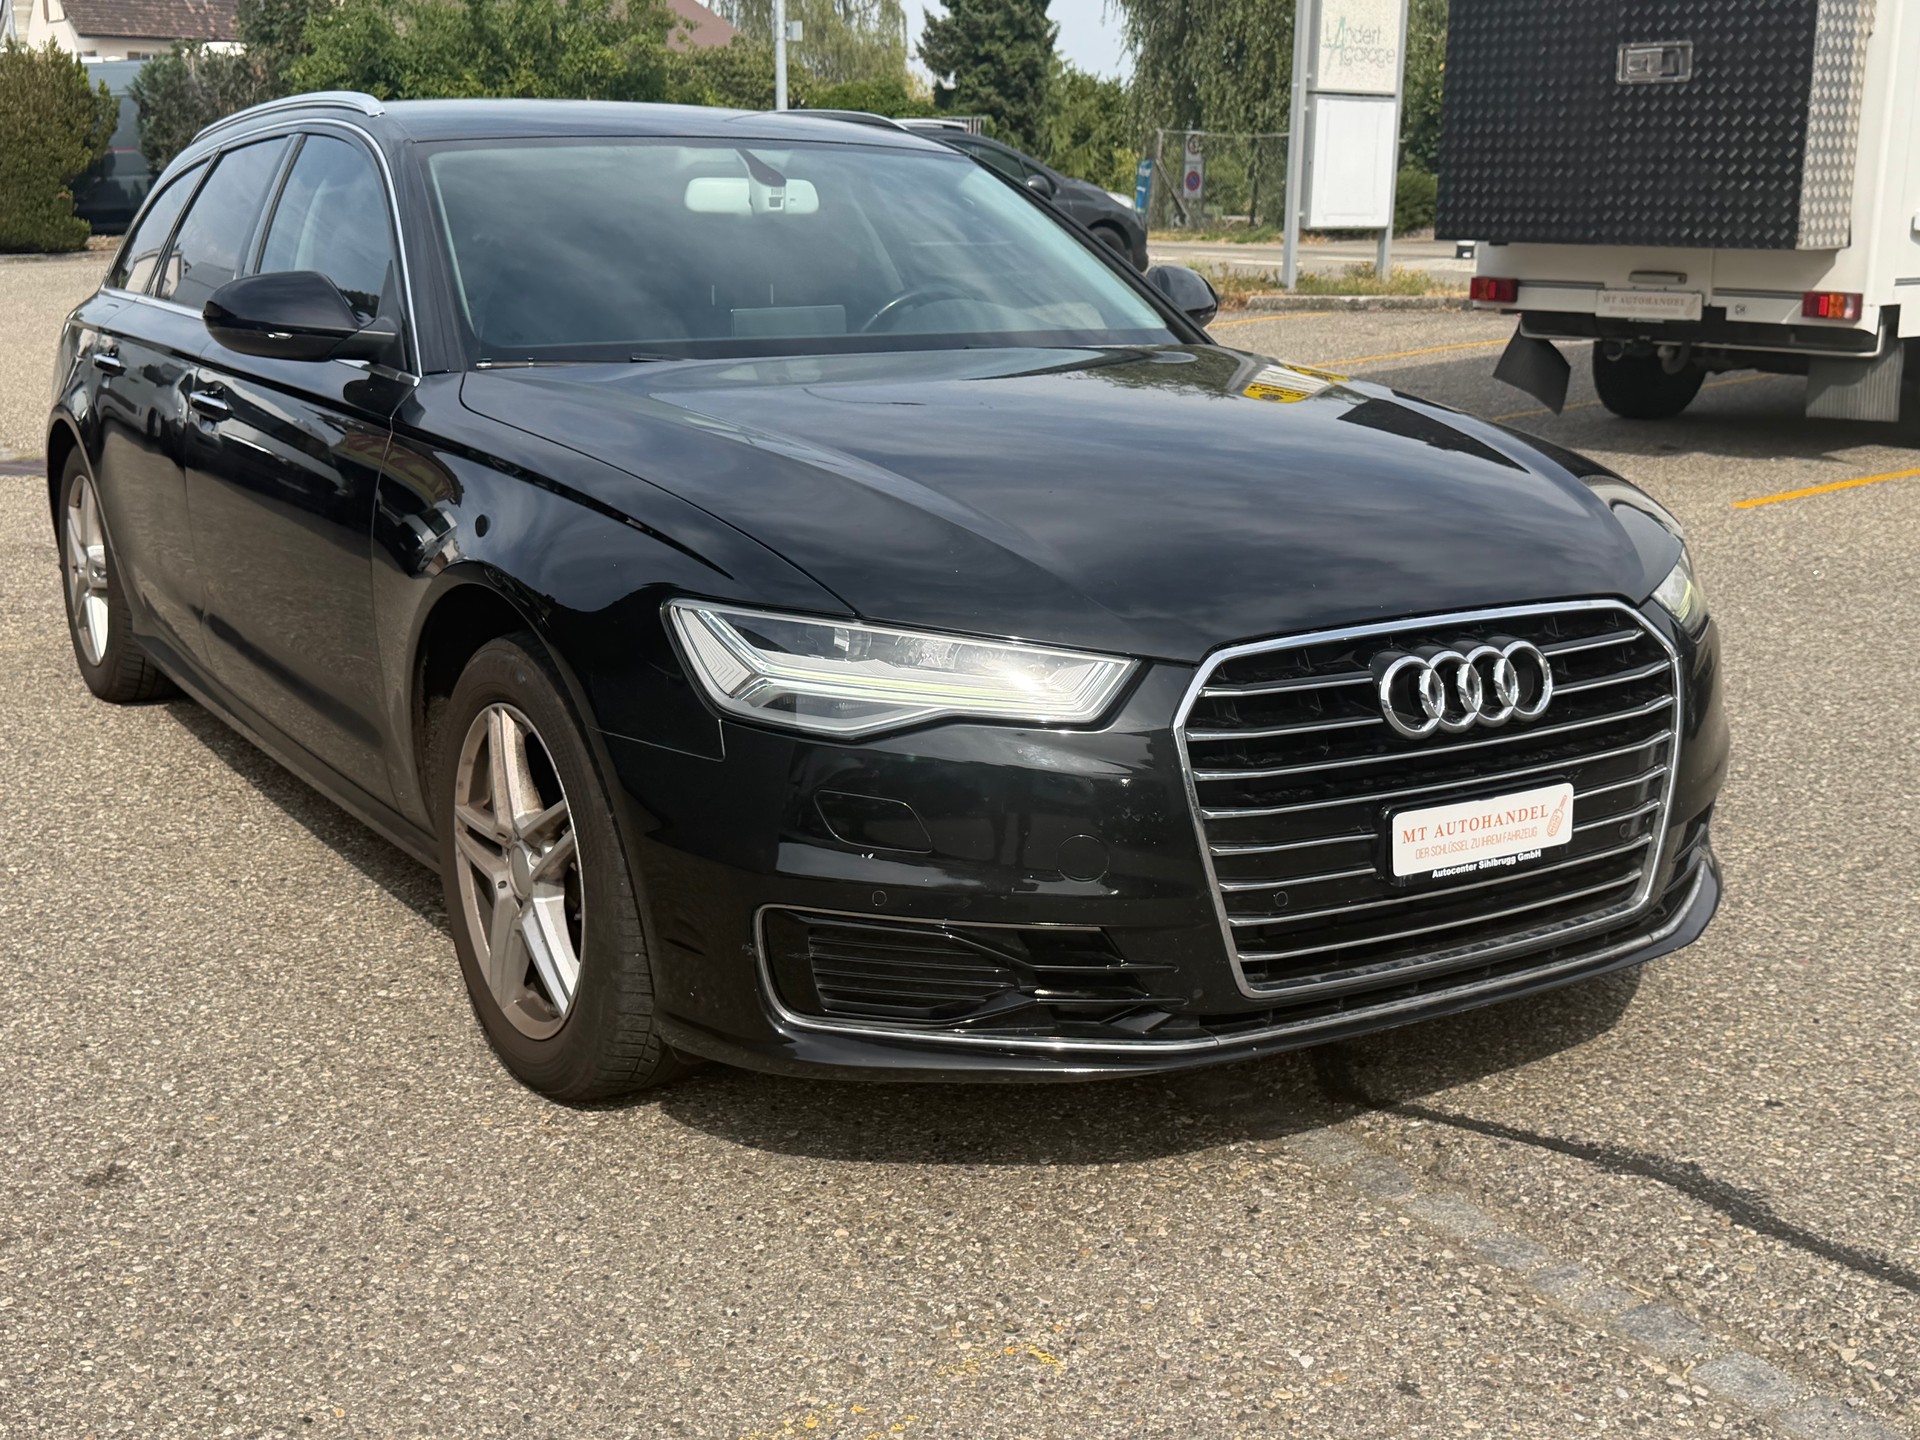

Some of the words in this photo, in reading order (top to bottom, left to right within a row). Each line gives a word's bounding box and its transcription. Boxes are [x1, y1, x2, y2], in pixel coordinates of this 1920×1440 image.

[1402, 826, 1428, 844] MT
[1434, 804, 1549, 838] AUTOHANDEL
[1415, 847, 1430, 860] DER
[1431, 839, 1469, 857] SCHLÜSSEL
[1470, 837, 1481, 849] ZU
[1481, 833, 1502, 847] IHREM
[1503, 826, 1538, 842] FAHRZEUG
[1432, 862, 1478, 879] Autocenter
[1478, 855, 1516, 870] Sihlbrugg
[1517, 848, 1542, 862] GmbH
